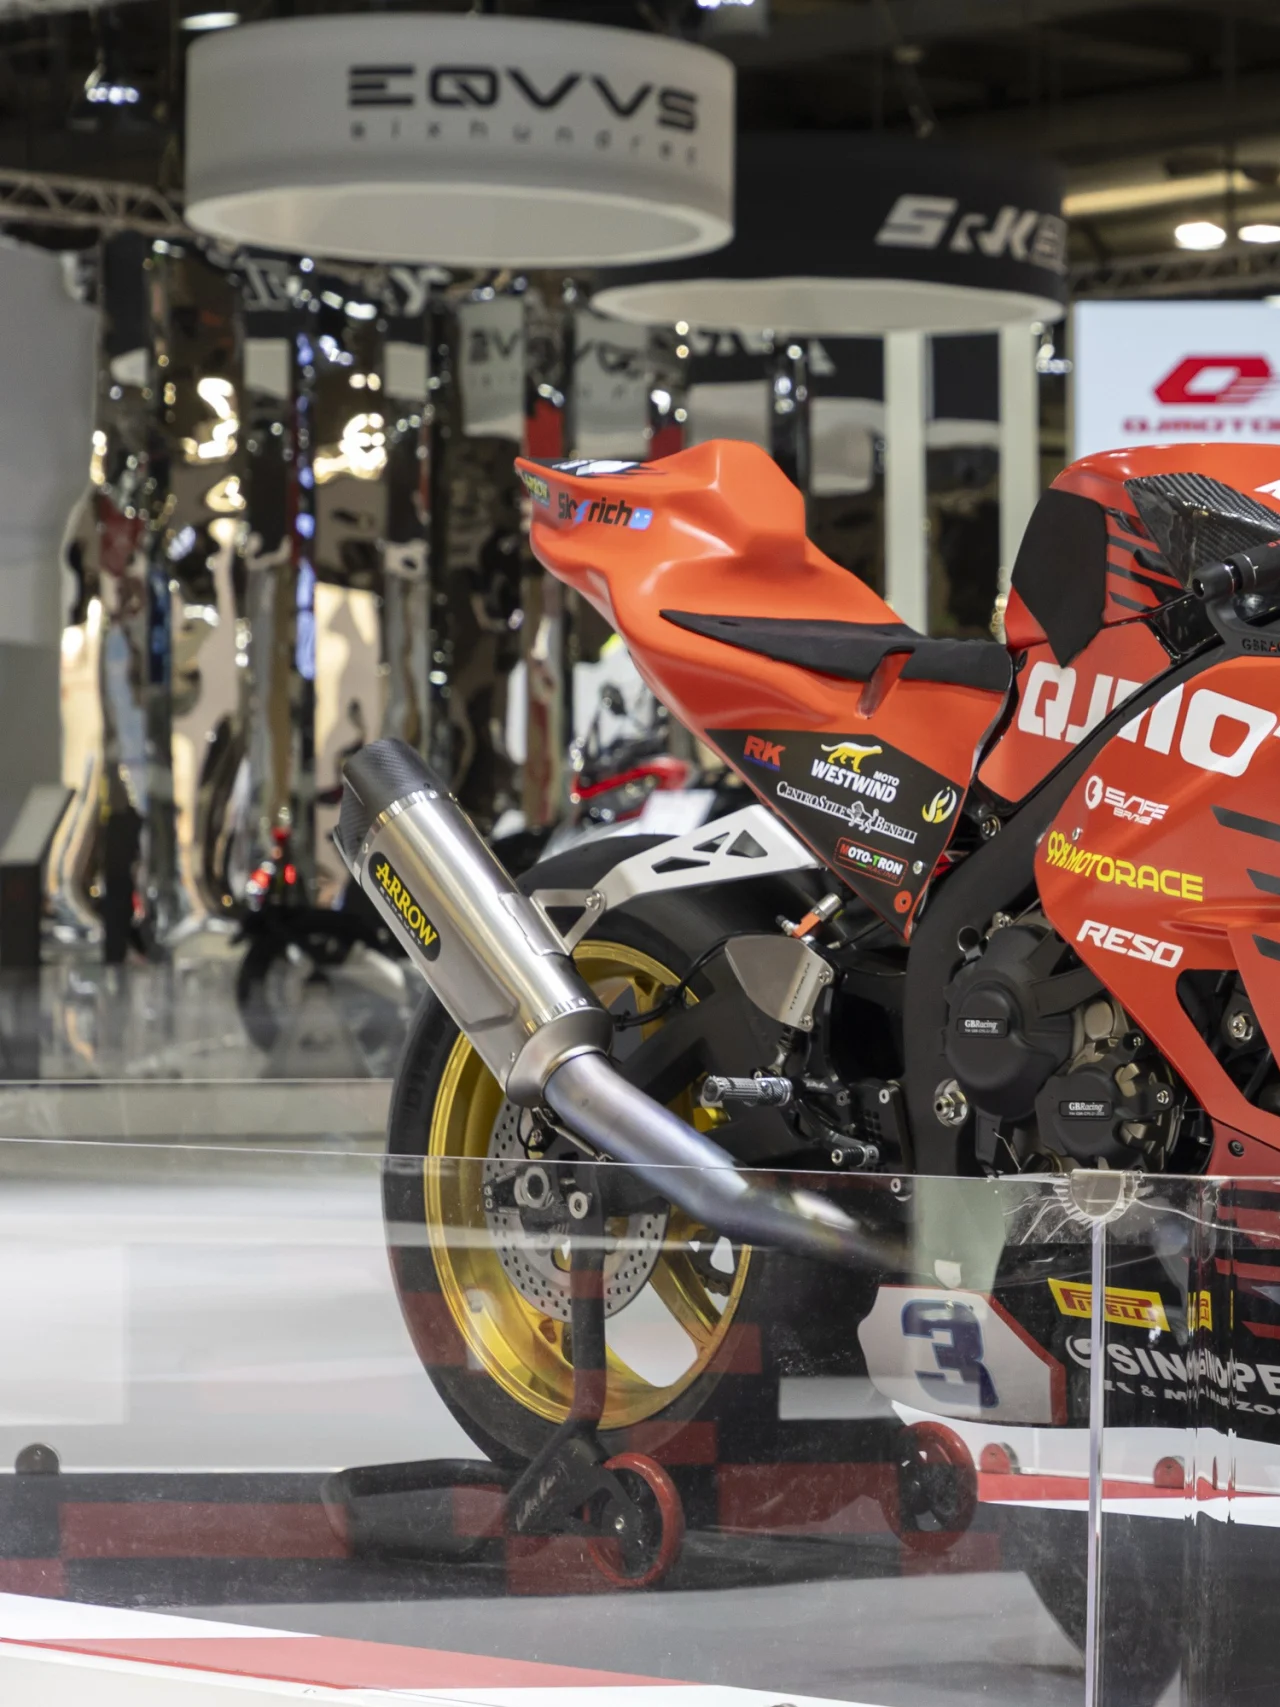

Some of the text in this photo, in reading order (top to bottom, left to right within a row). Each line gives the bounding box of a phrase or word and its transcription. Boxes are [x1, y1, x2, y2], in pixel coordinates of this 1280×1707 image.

[743, 735, 787, 767] RK
[810, 758, 898, 804] WESTWIND
[872, 770, 900, 787] MOTO
[376, 862, 438, 946] ARROW
[1076, 919, 1184, 969] RESO
[902, 1298, 999, 1409] 3
